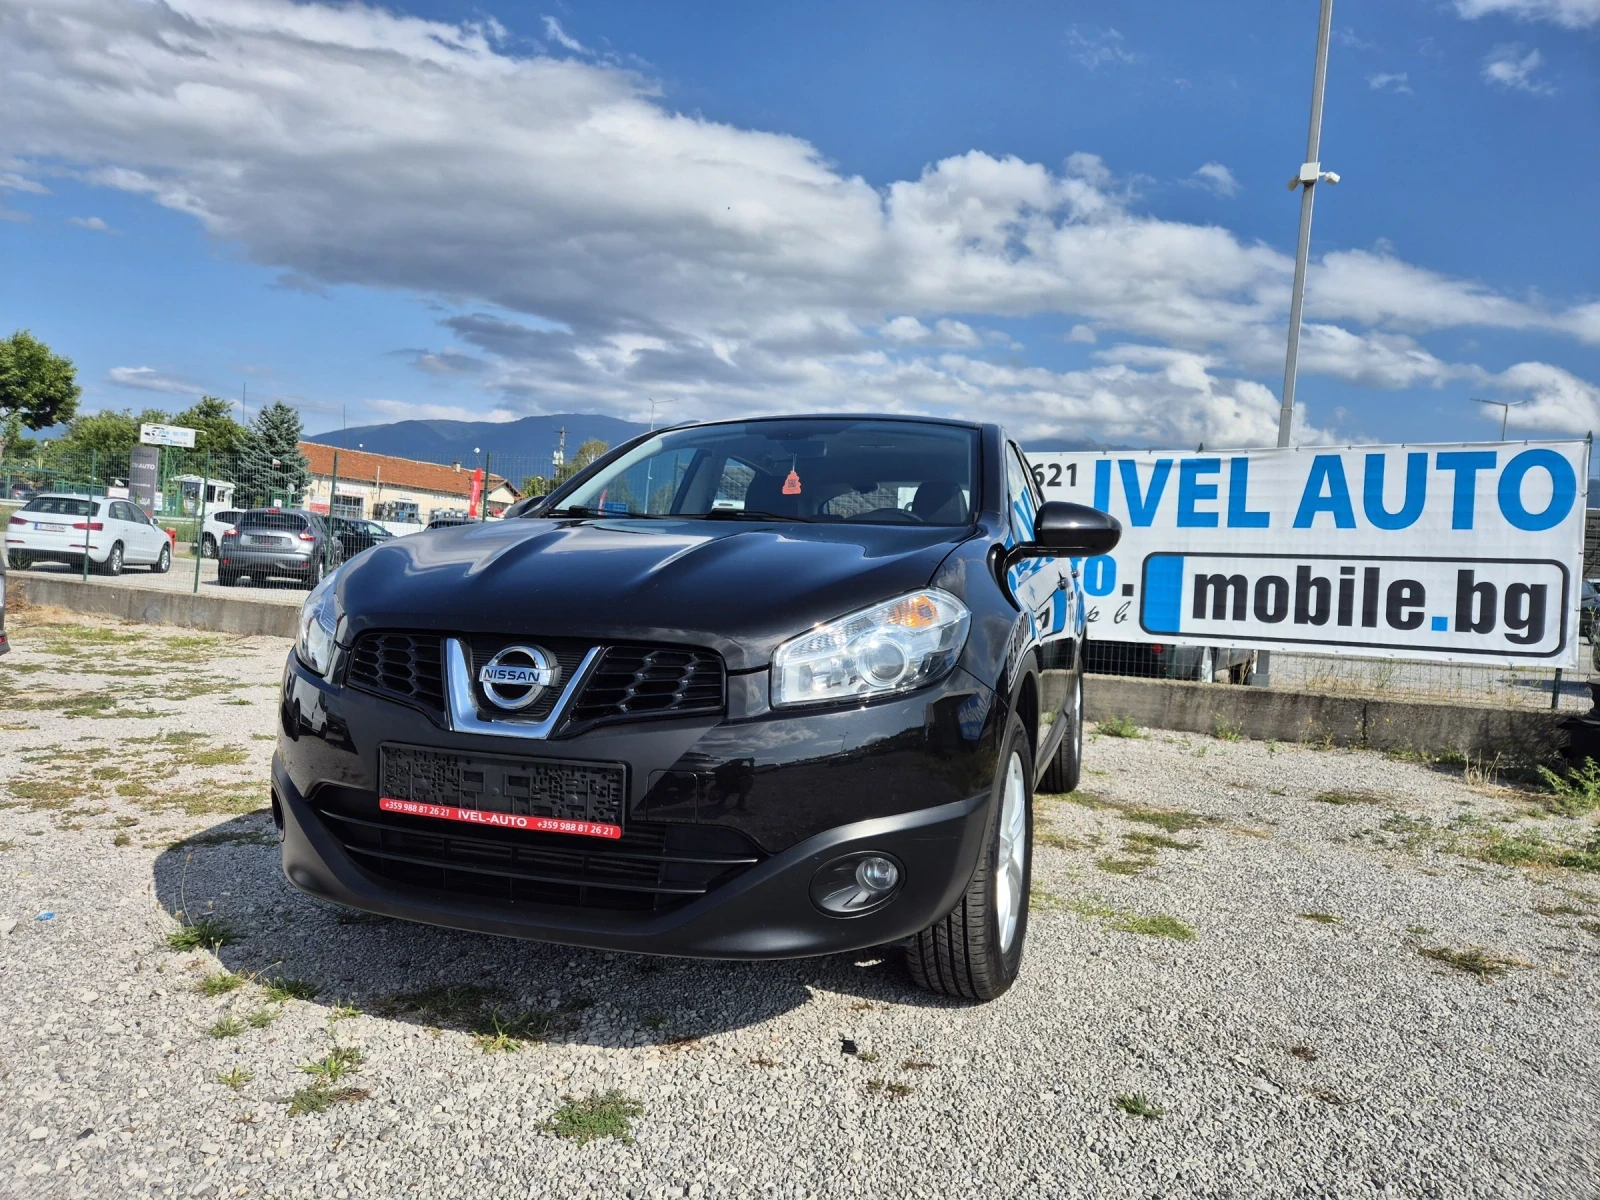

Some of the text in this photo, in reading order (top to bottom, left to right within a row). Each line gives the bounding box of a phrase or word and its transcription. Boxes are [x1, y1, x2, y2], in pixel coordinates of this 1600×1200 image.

[1094, 448, 1577, 531] IVEL AUTO
[1192, 565, 1548, 645] mobile.bg
[484, 669, 540, 682] NISSAN
[385, 801, 614, 836] +359 988 81 26 21 IVEL-AUTO +359 988 81 26 21
